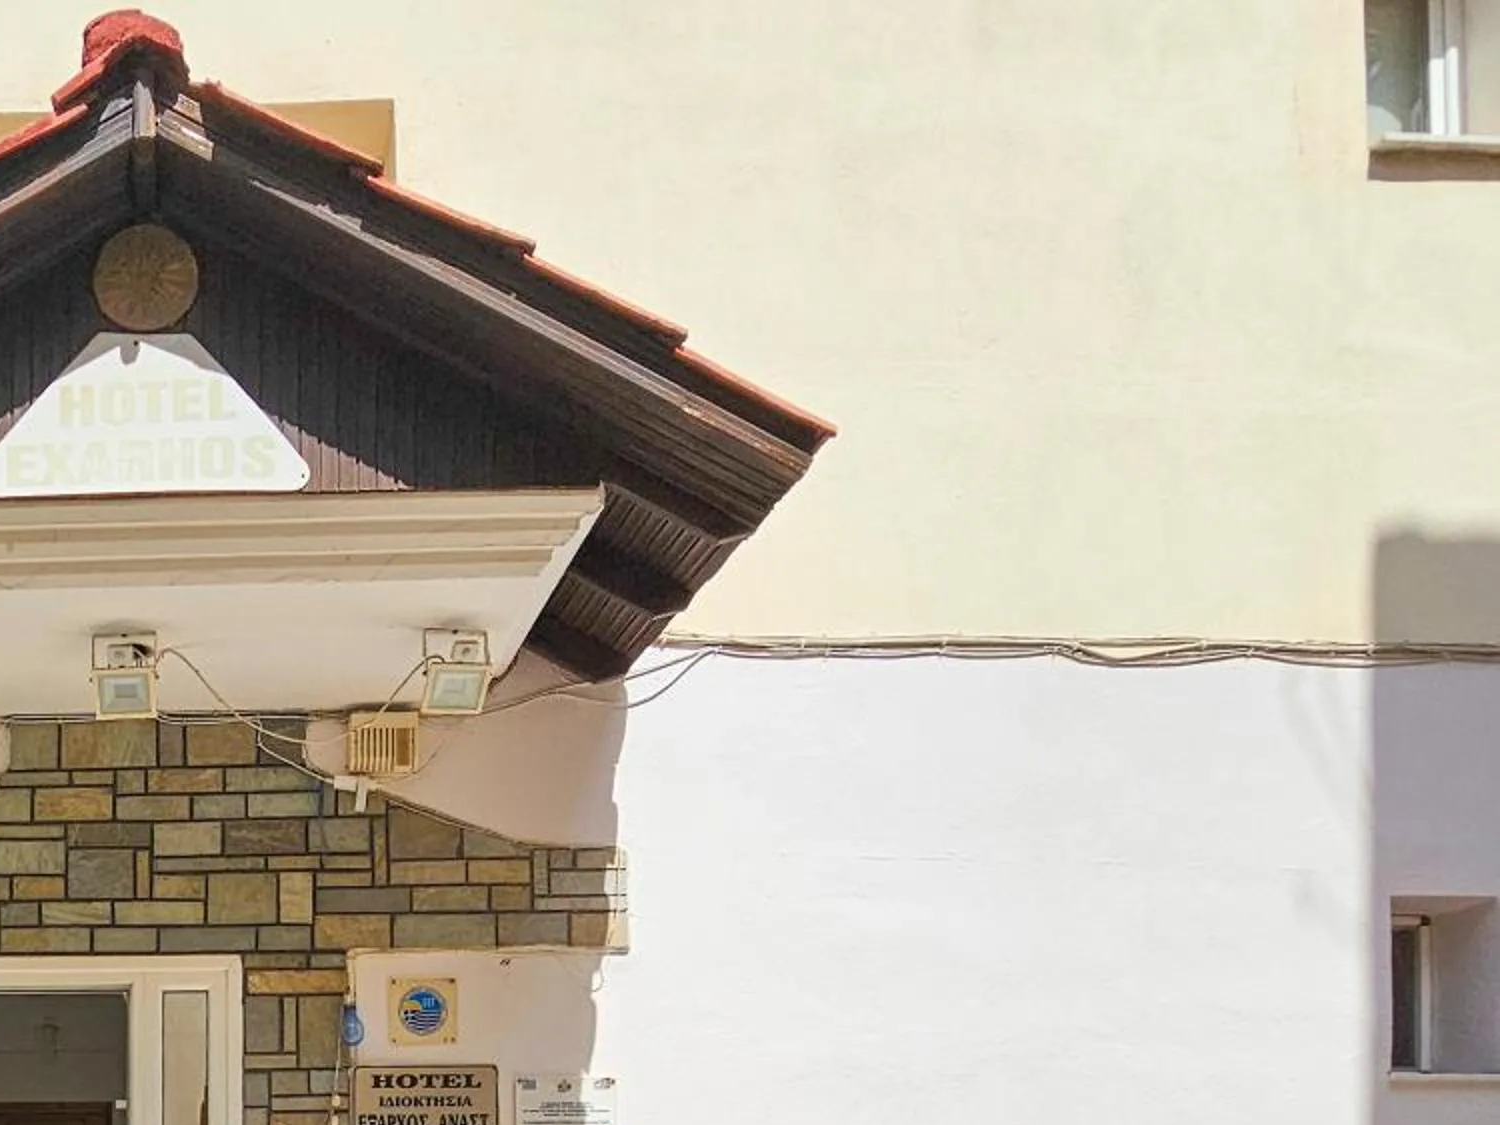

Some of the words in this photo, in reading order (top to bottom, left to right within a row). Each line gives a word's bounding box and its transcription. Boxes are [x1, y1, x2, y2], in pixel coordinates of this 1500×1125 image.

[58, 378, 237, 428] HOTEL
[371, 1073, 482, 1089] HOTEL
[379, 1095, 473, 1107] ΙΔΙΟΚΤΗΣΙΑ
